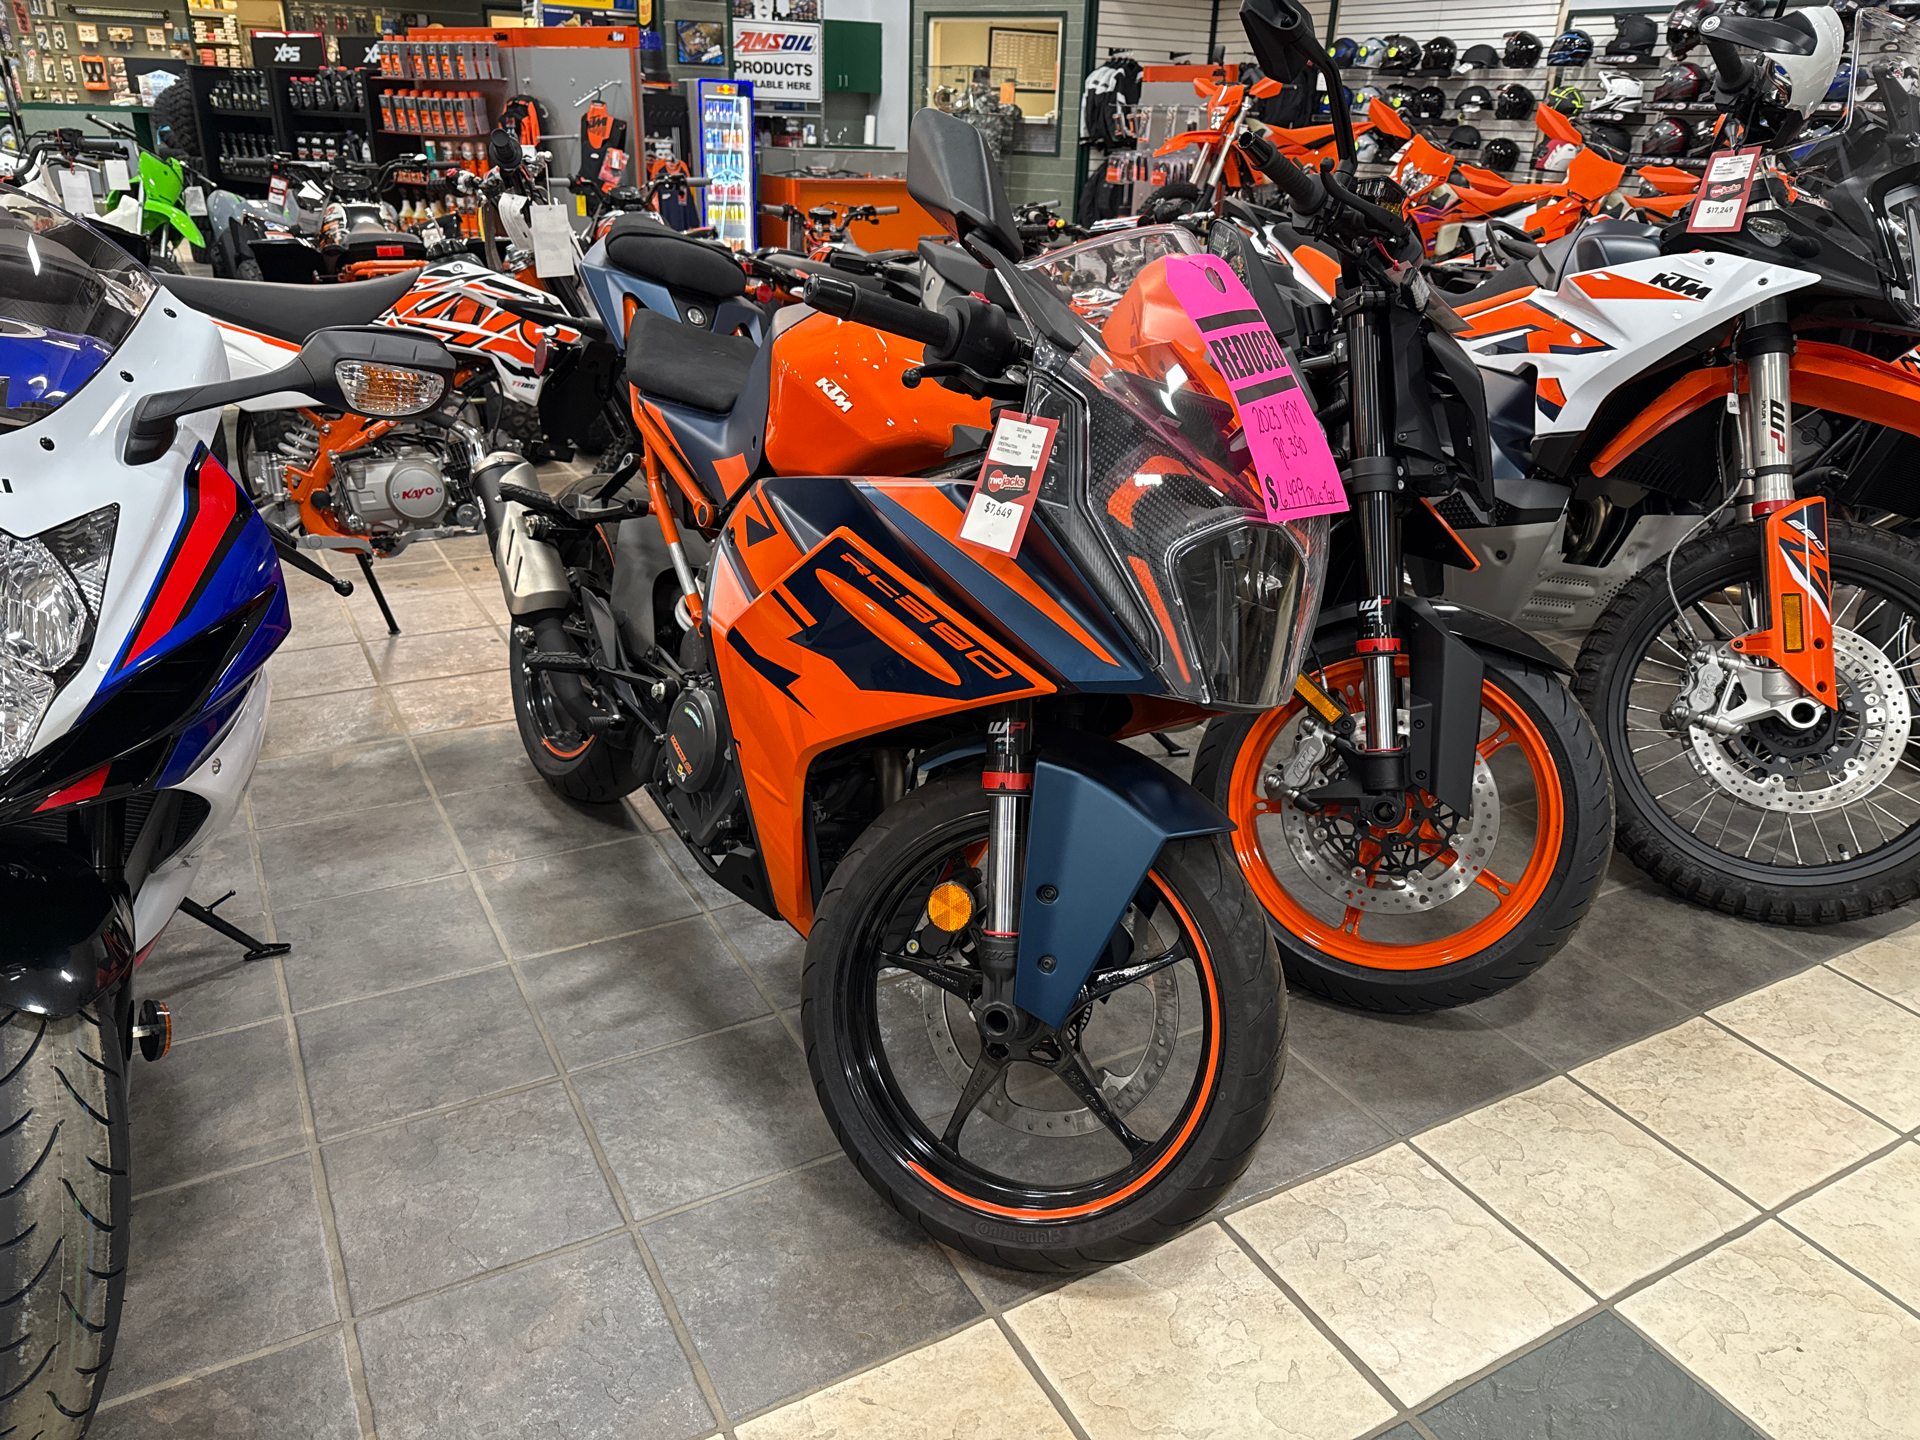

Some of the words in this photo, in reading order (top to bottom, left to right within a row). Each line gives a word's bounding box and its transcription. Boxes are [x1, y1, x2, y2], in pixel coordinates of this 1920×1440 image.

[734, 31, 813, 53] AMSOIL
[274, 43, 300, 62] XPS
[363, 44, 381, 63] XP
[734, 60, 813, 76] PRODUCTS
[786, 81, 812, 91] HERE
[1706, 206, 1734, 215] $17,249
[1648, 271, 1713, 300] KTM
[1208, 330, 1287, 382] REDUCED
[815, 377, 854, 414] KTM
[1251, 406, 1283, 434] 2023
[1279, 400, 1307, 434] KTM
[1770, 398, 1786, 454] WP
[1287, 434, 1308, 456] 390
[989, 477, 1003, 485] TWO
[1000, 474, 1026, 489] jacks
[402, 487, 435, 500] KAYO
[984, 501, 1013, 519] $7,649
[1358, 599, 1392, 611] WP
[987, 721, 1027, 735] WP
[1670, 850, 1734, 886] ENDURO
[974, 1220, 1053, 1244] Continental
